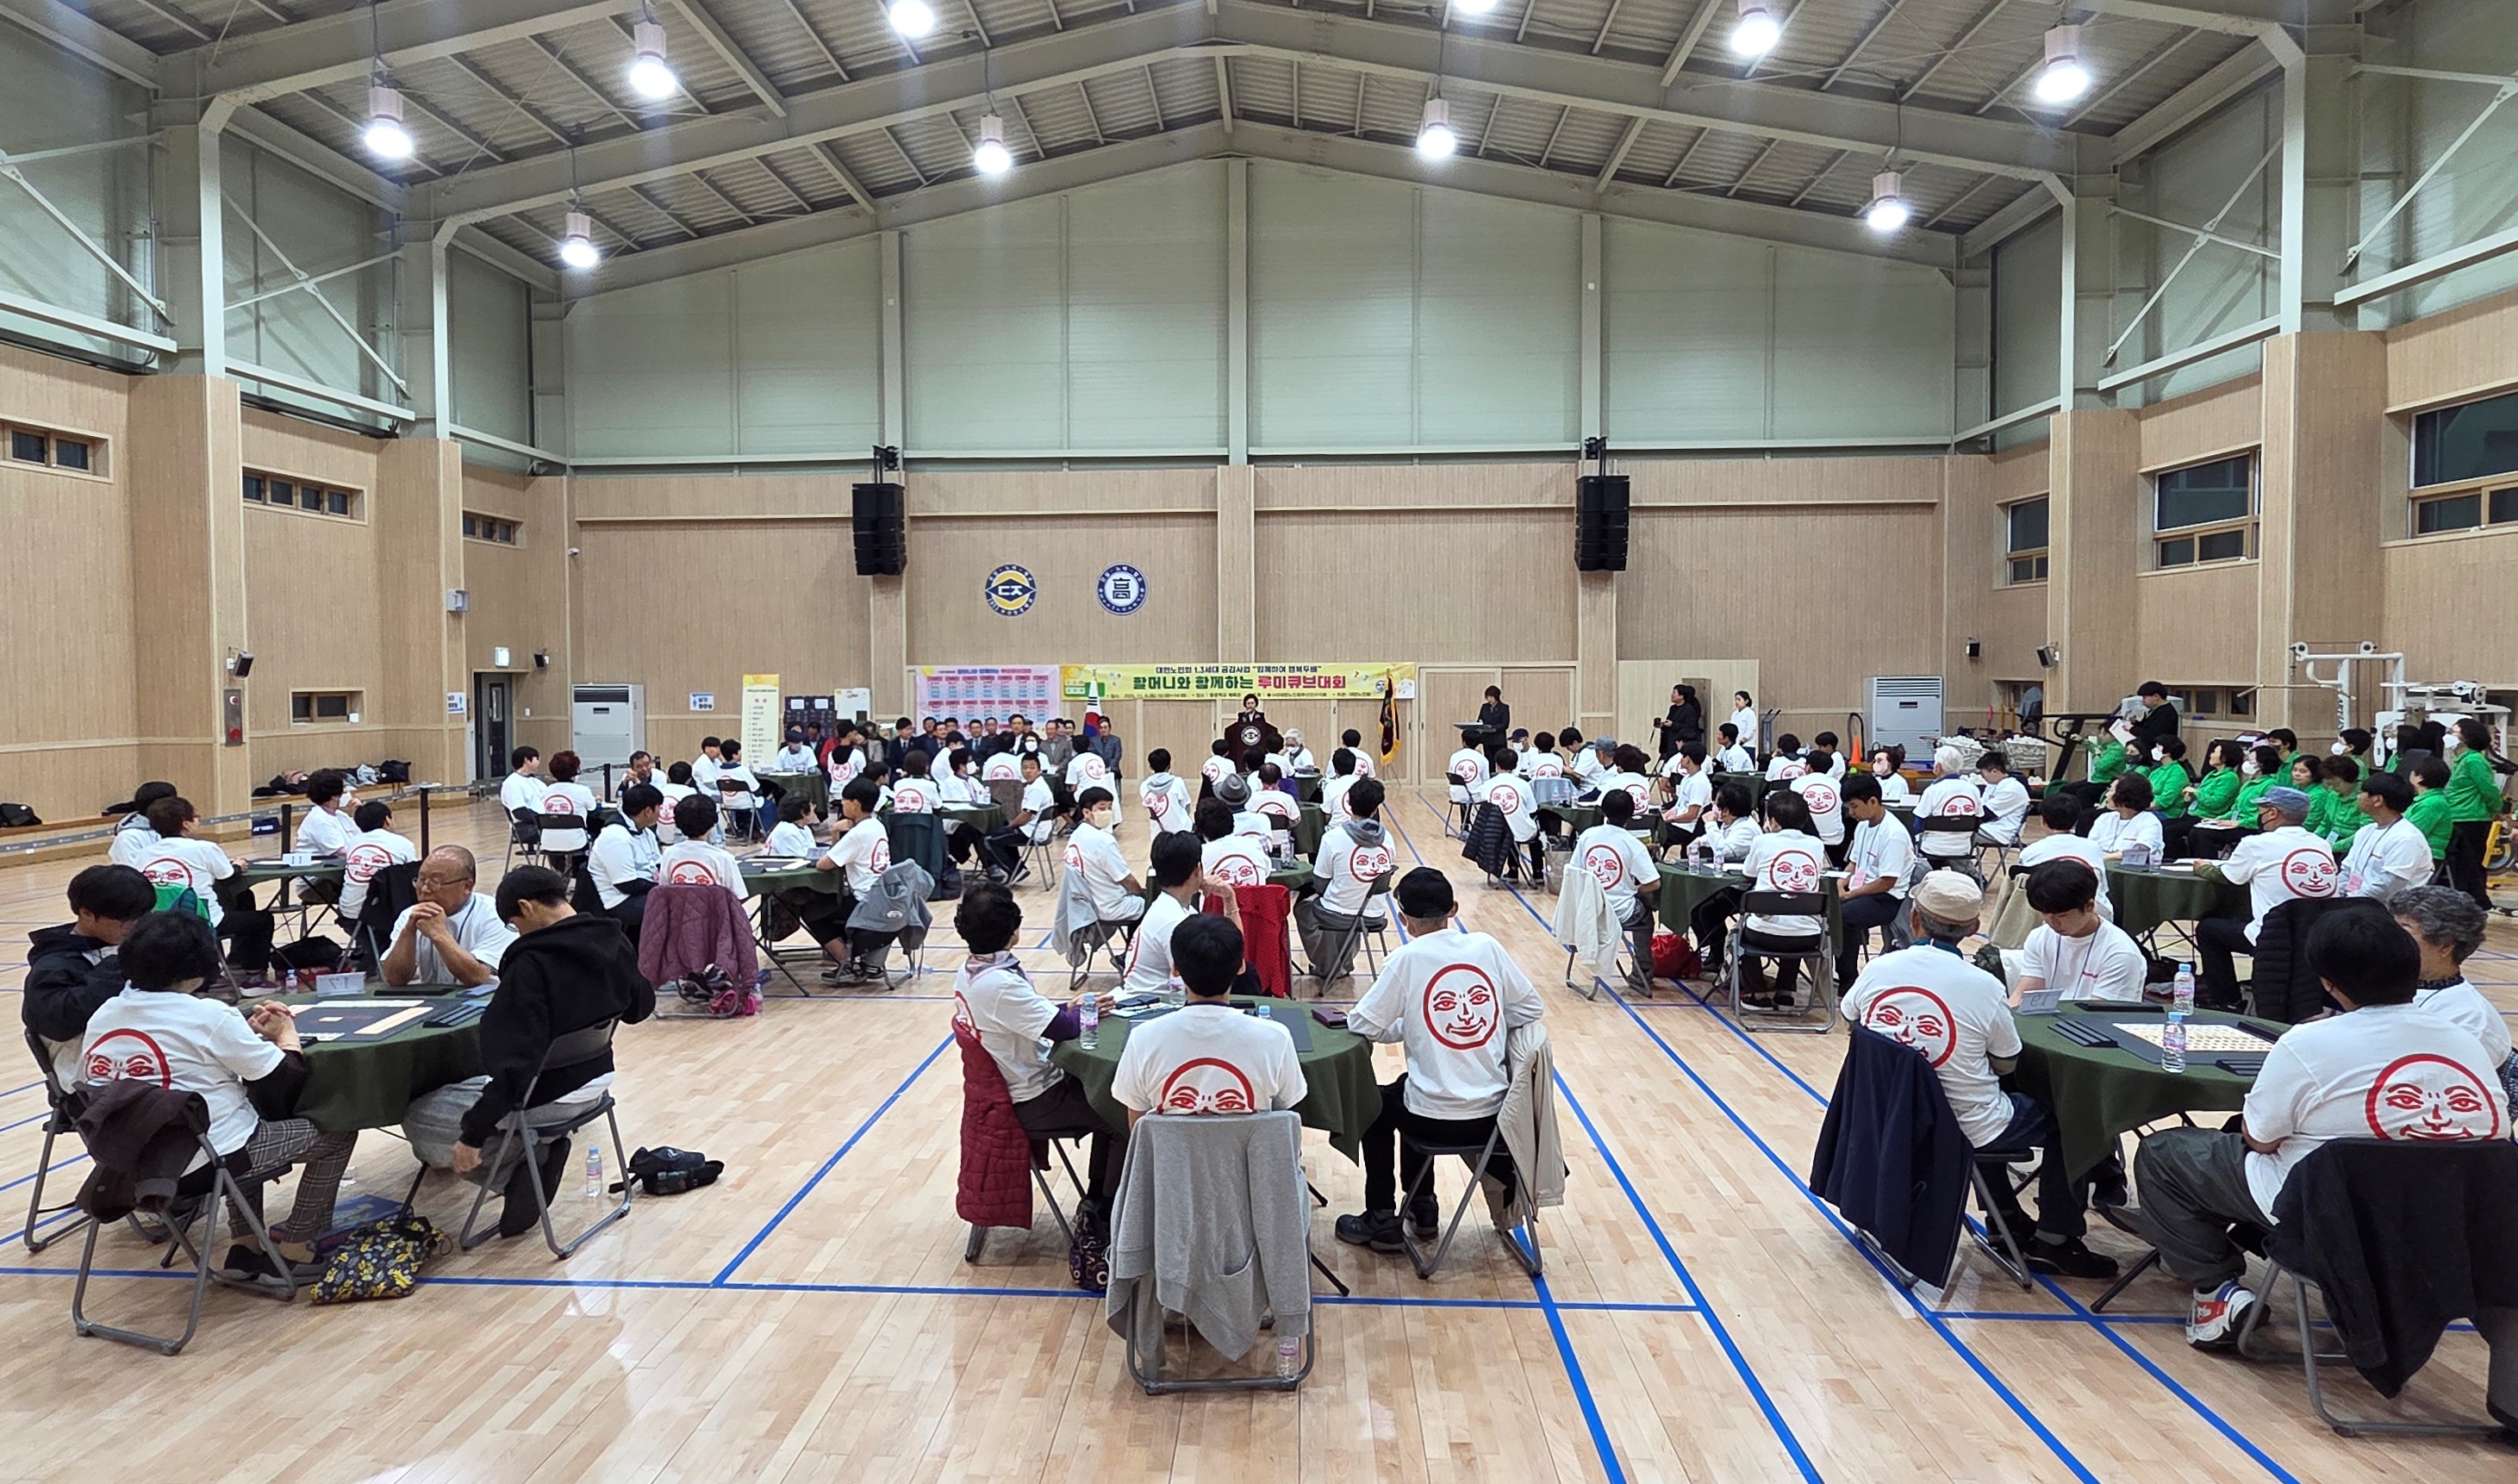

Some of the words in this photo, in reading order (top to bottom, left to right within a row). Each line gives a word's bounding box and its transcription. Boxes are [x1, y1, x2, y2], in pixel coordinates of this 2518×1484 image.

[1132, 676, 1191, 689] 할머니와
[1195, 676, 1254, 689] 함께하는
[1257, 675, 1346, 689] 루미큐브대회
